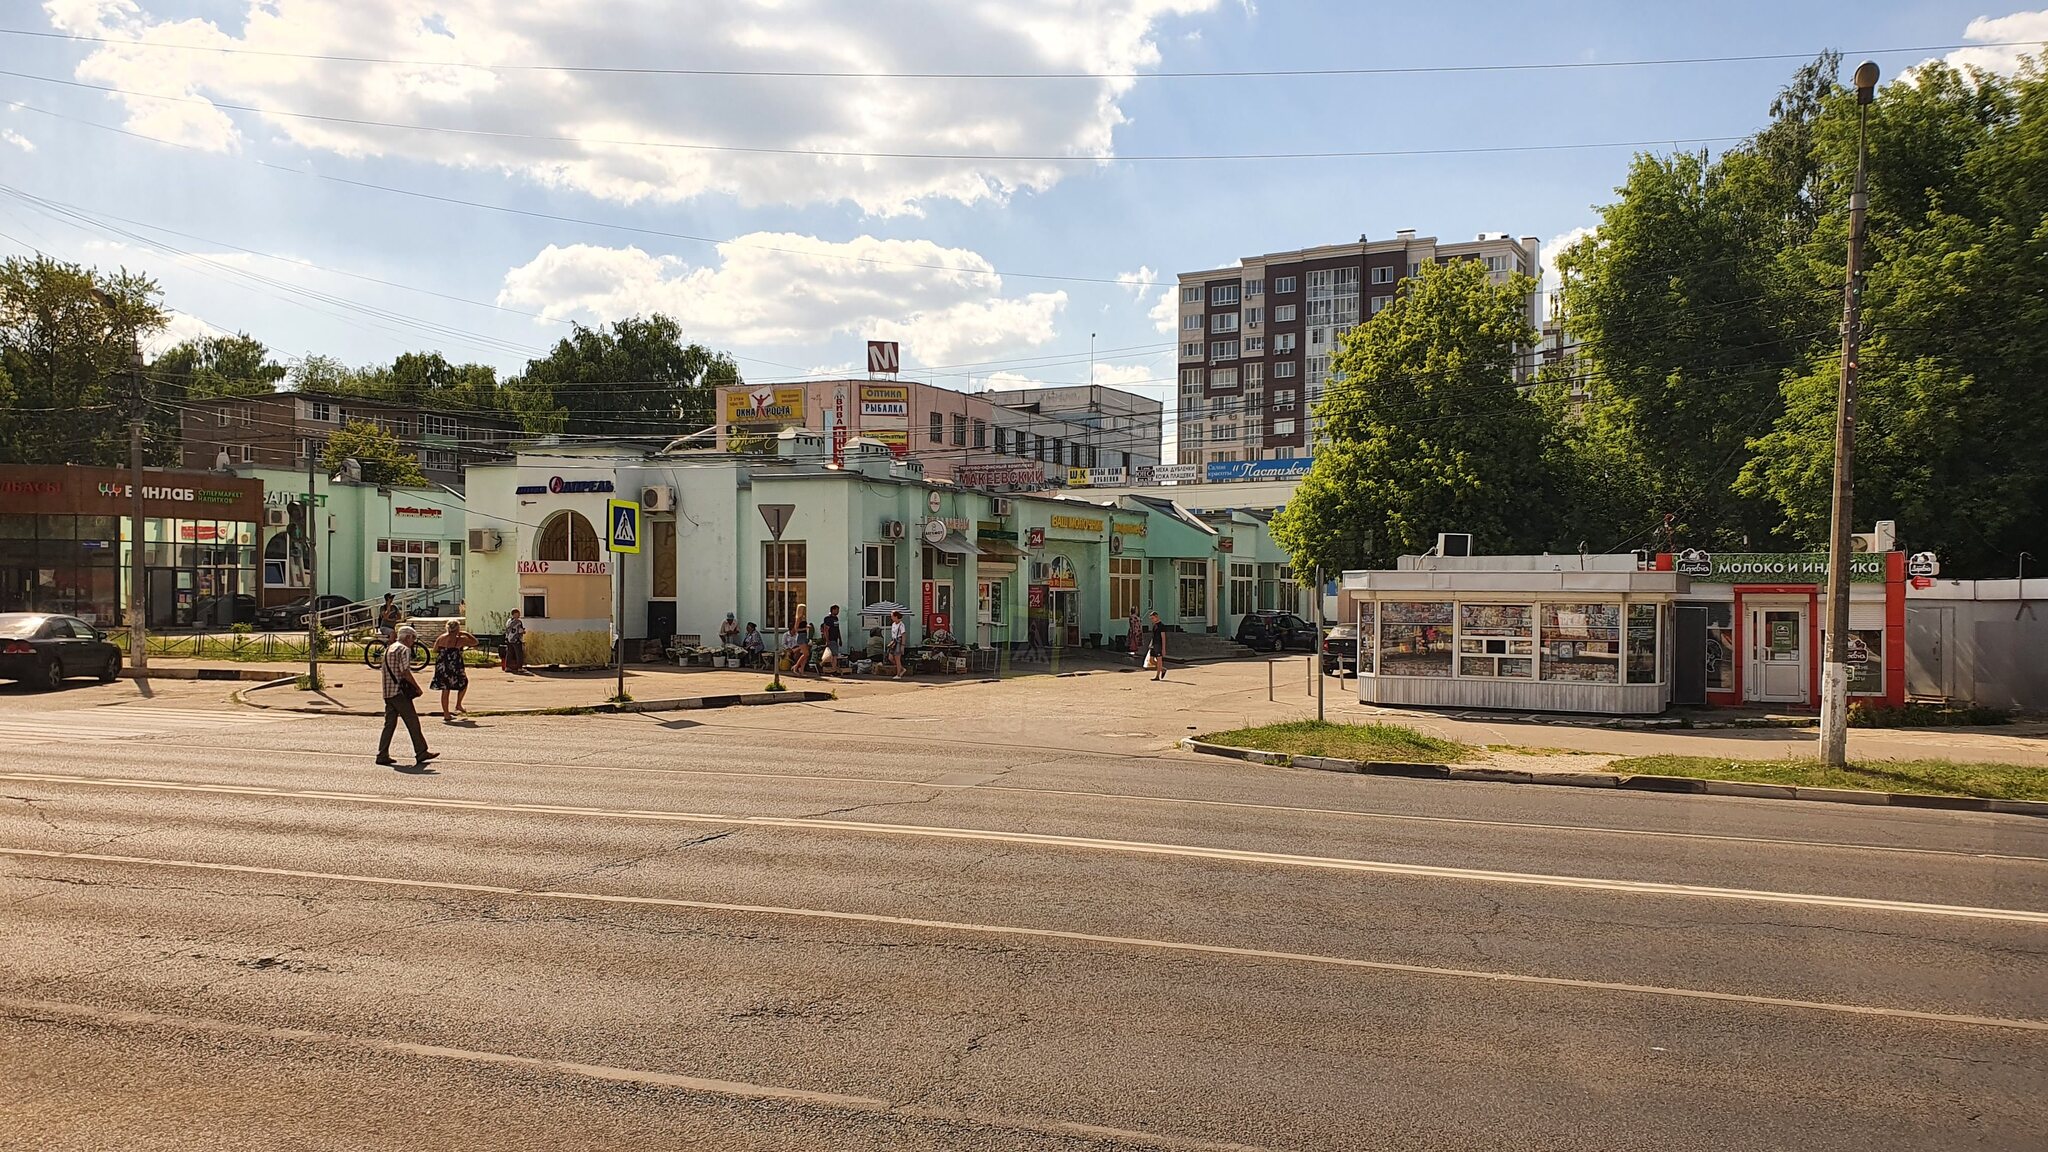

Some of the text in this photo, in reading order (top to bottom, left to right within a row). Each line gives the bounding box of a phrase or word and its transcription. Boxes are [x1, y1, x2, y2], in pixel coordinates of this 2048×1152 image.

[736, 408, 756, 417] ОКНА
[766, 405, 791, 416] РОСТА
[865, 403, 903, 413] РЫБАЛКА
[960, 469, 1045, 486] МАКЕЕВСКИЙ
[198, 490, 244, 498] СУПЕРМАРКЕТ
[198, 496, 233, 504] НАПИТКОВ
[1051, 515, 1068, 528] ВАШ
[1031, 534, 1042, 544] 24
[517, 561, 606, 574] КВАС КВАС
[1029, 594, 1041, 605] 24
